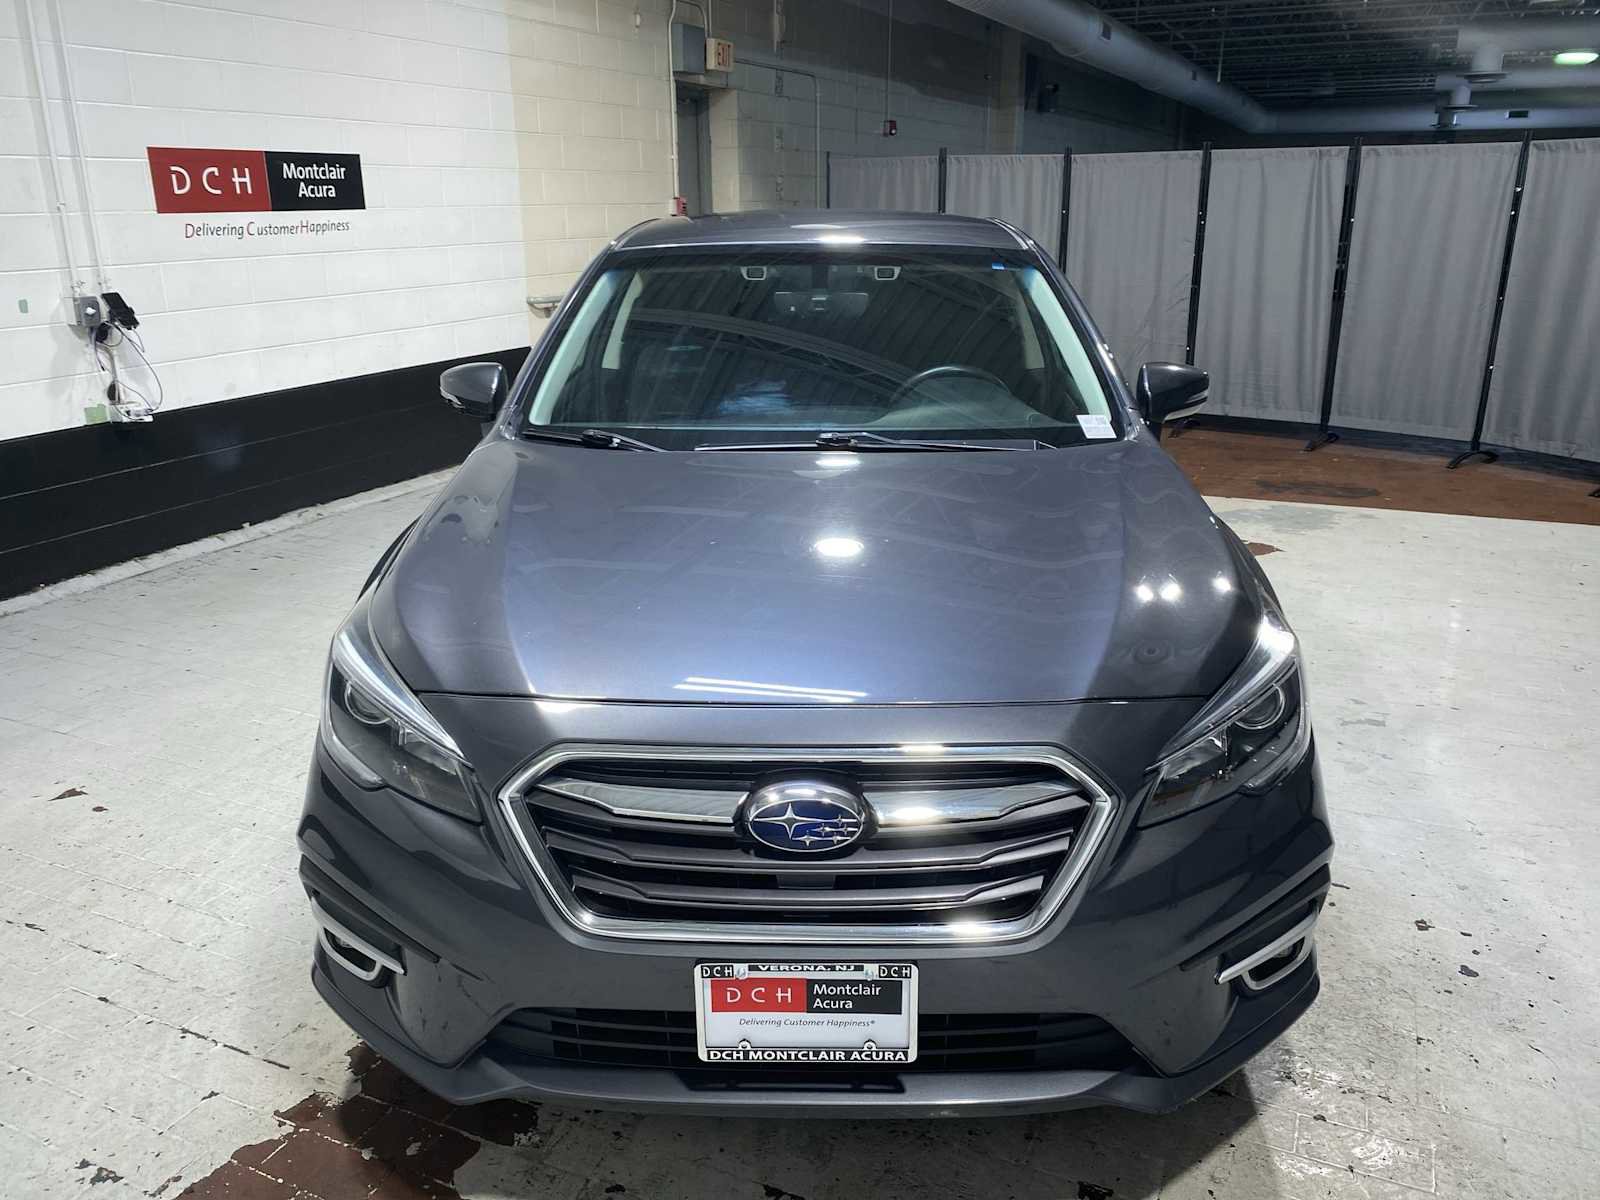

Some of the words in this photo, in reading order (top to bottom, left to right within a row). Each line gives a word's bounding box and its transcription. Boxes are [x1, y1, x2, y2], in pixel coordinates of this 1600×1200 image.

[282, 162, 346, 180] Montclair
[169, 166, 252, 194] DCH
[298, 181, 337, 198] Acura
[185, 223, 244, 239] Delivering
[702, 966, 734, 978] DCH
[880, 966, 911, 978] DCH
[727, 987, 792, 1003] DCH
[812, 983, 882, 996] Montclair
[812, 998, 853, 1010] Acura
[739, 1018, 782, 1028] Delivering
[783, 1018, 825, 1027] Customer
[709, 1050, 744, 1061] DCH
[749, 1050, 846, 1061] MONTCLAIR
[850, 1050, 906, 1061] ACURA
